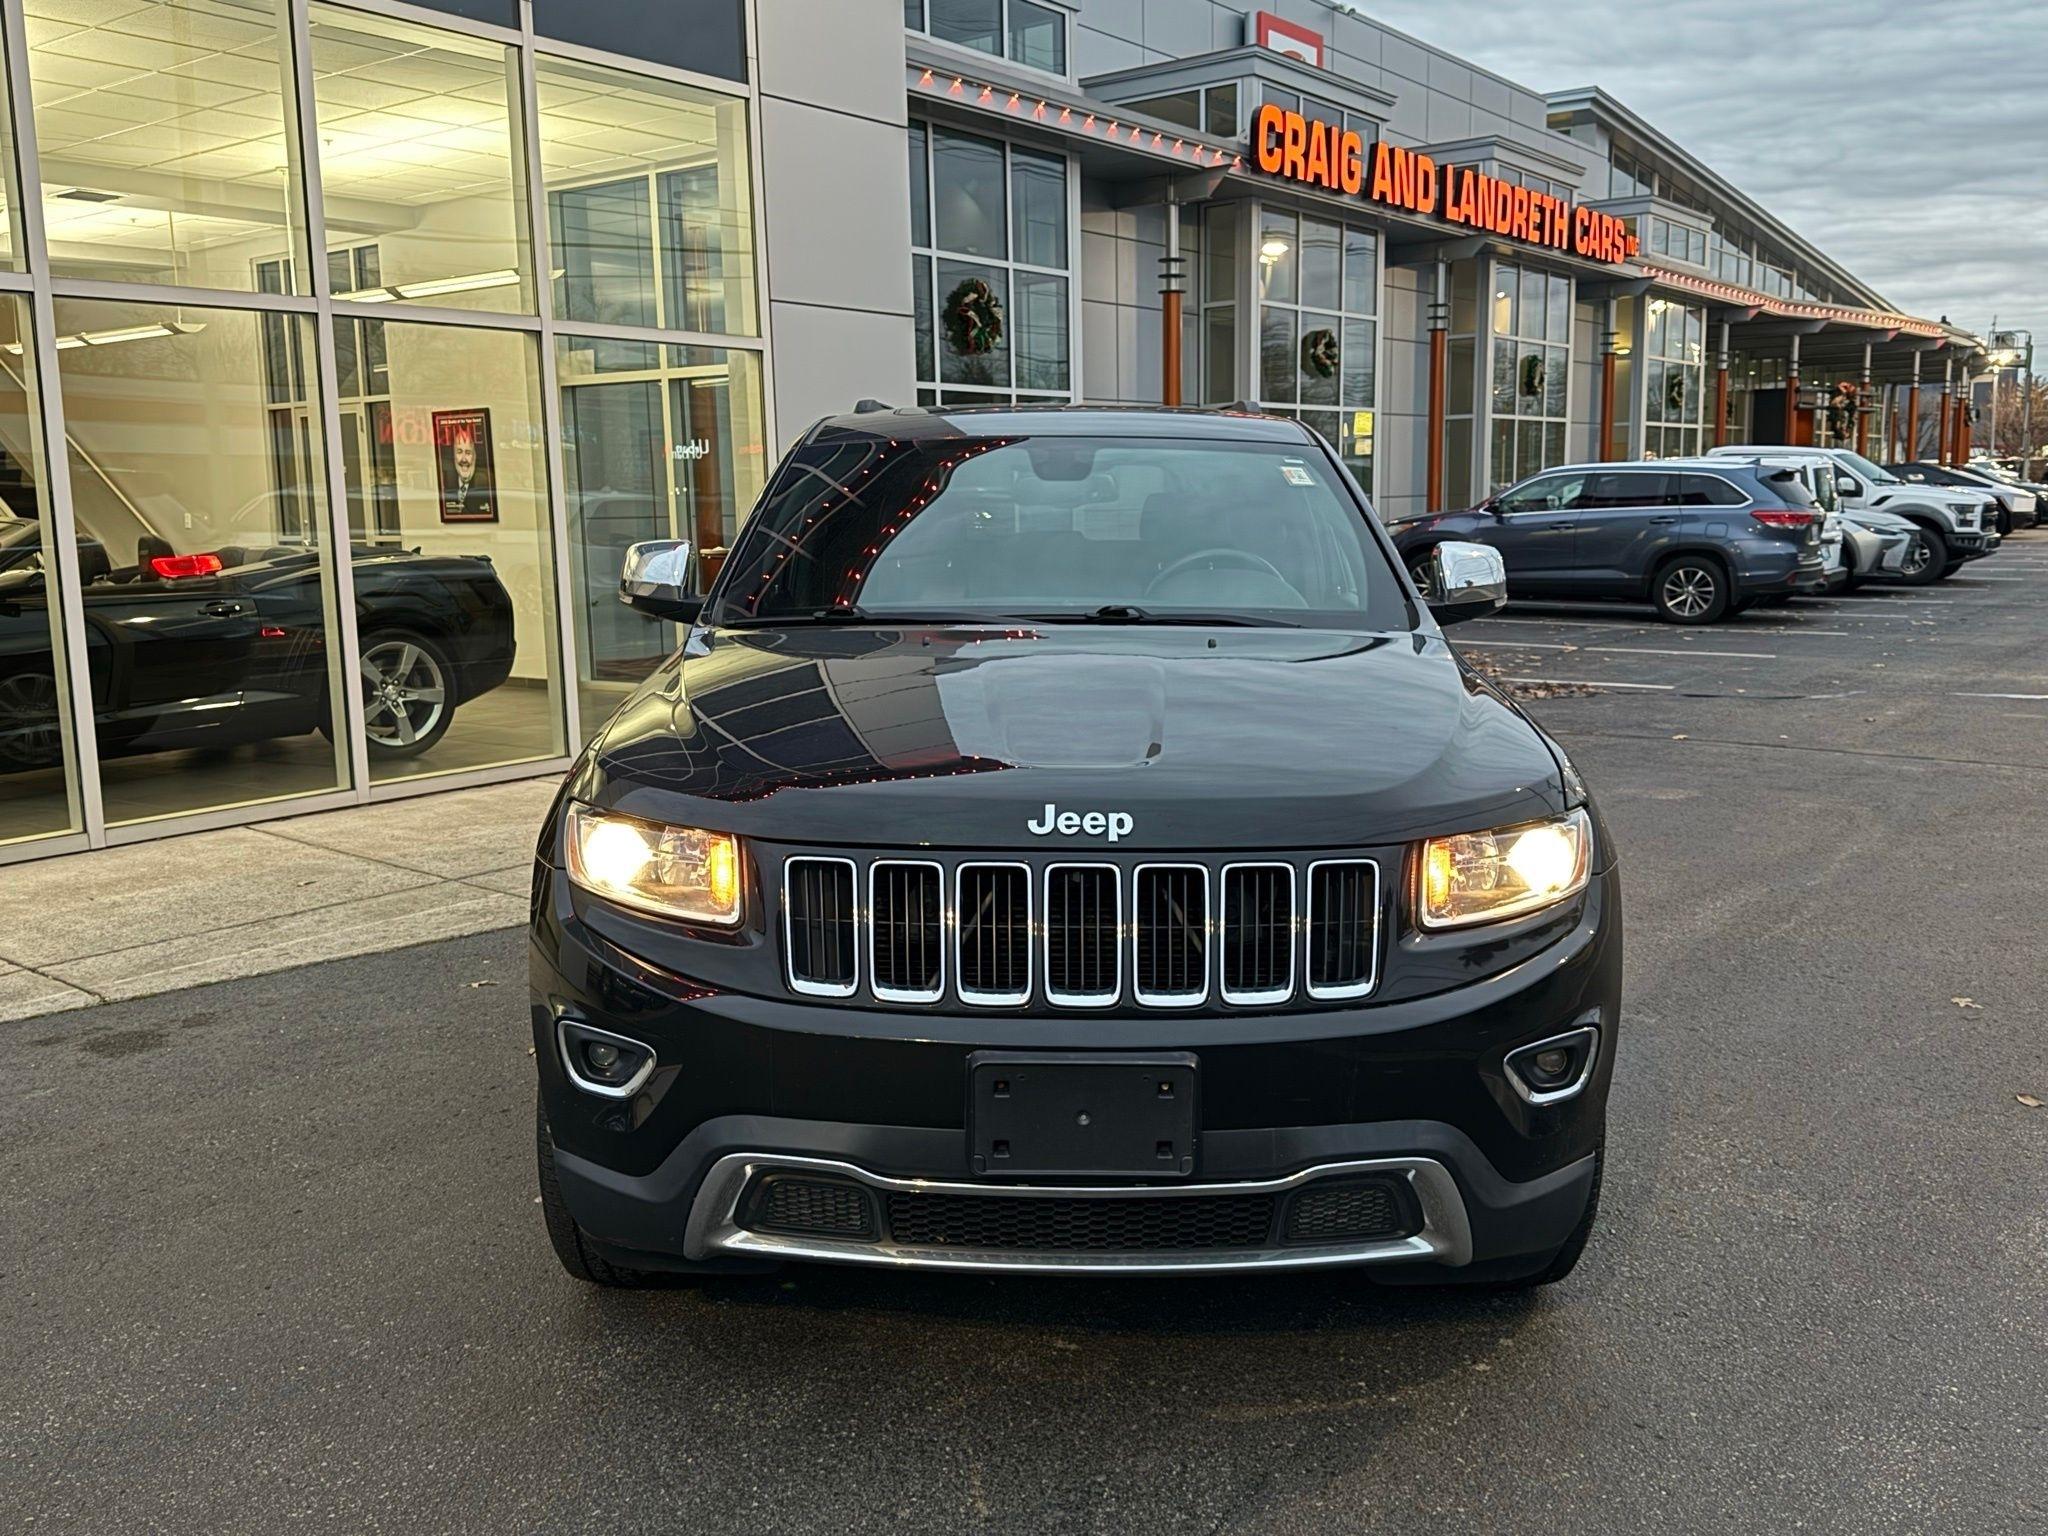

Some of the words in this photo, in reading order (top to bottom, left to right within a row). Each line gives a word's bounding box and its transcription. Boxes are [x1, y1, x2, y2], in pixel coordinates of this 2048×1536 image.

[1257, 104, 1363, 195] CRAIG
[1372, 141, 1437, 214] AND
[1446, 164, 1569, 250] LANDRETH
[1575, 206, 1625, 264] CARS
[1027, 804, 1134, 842] Jeep
